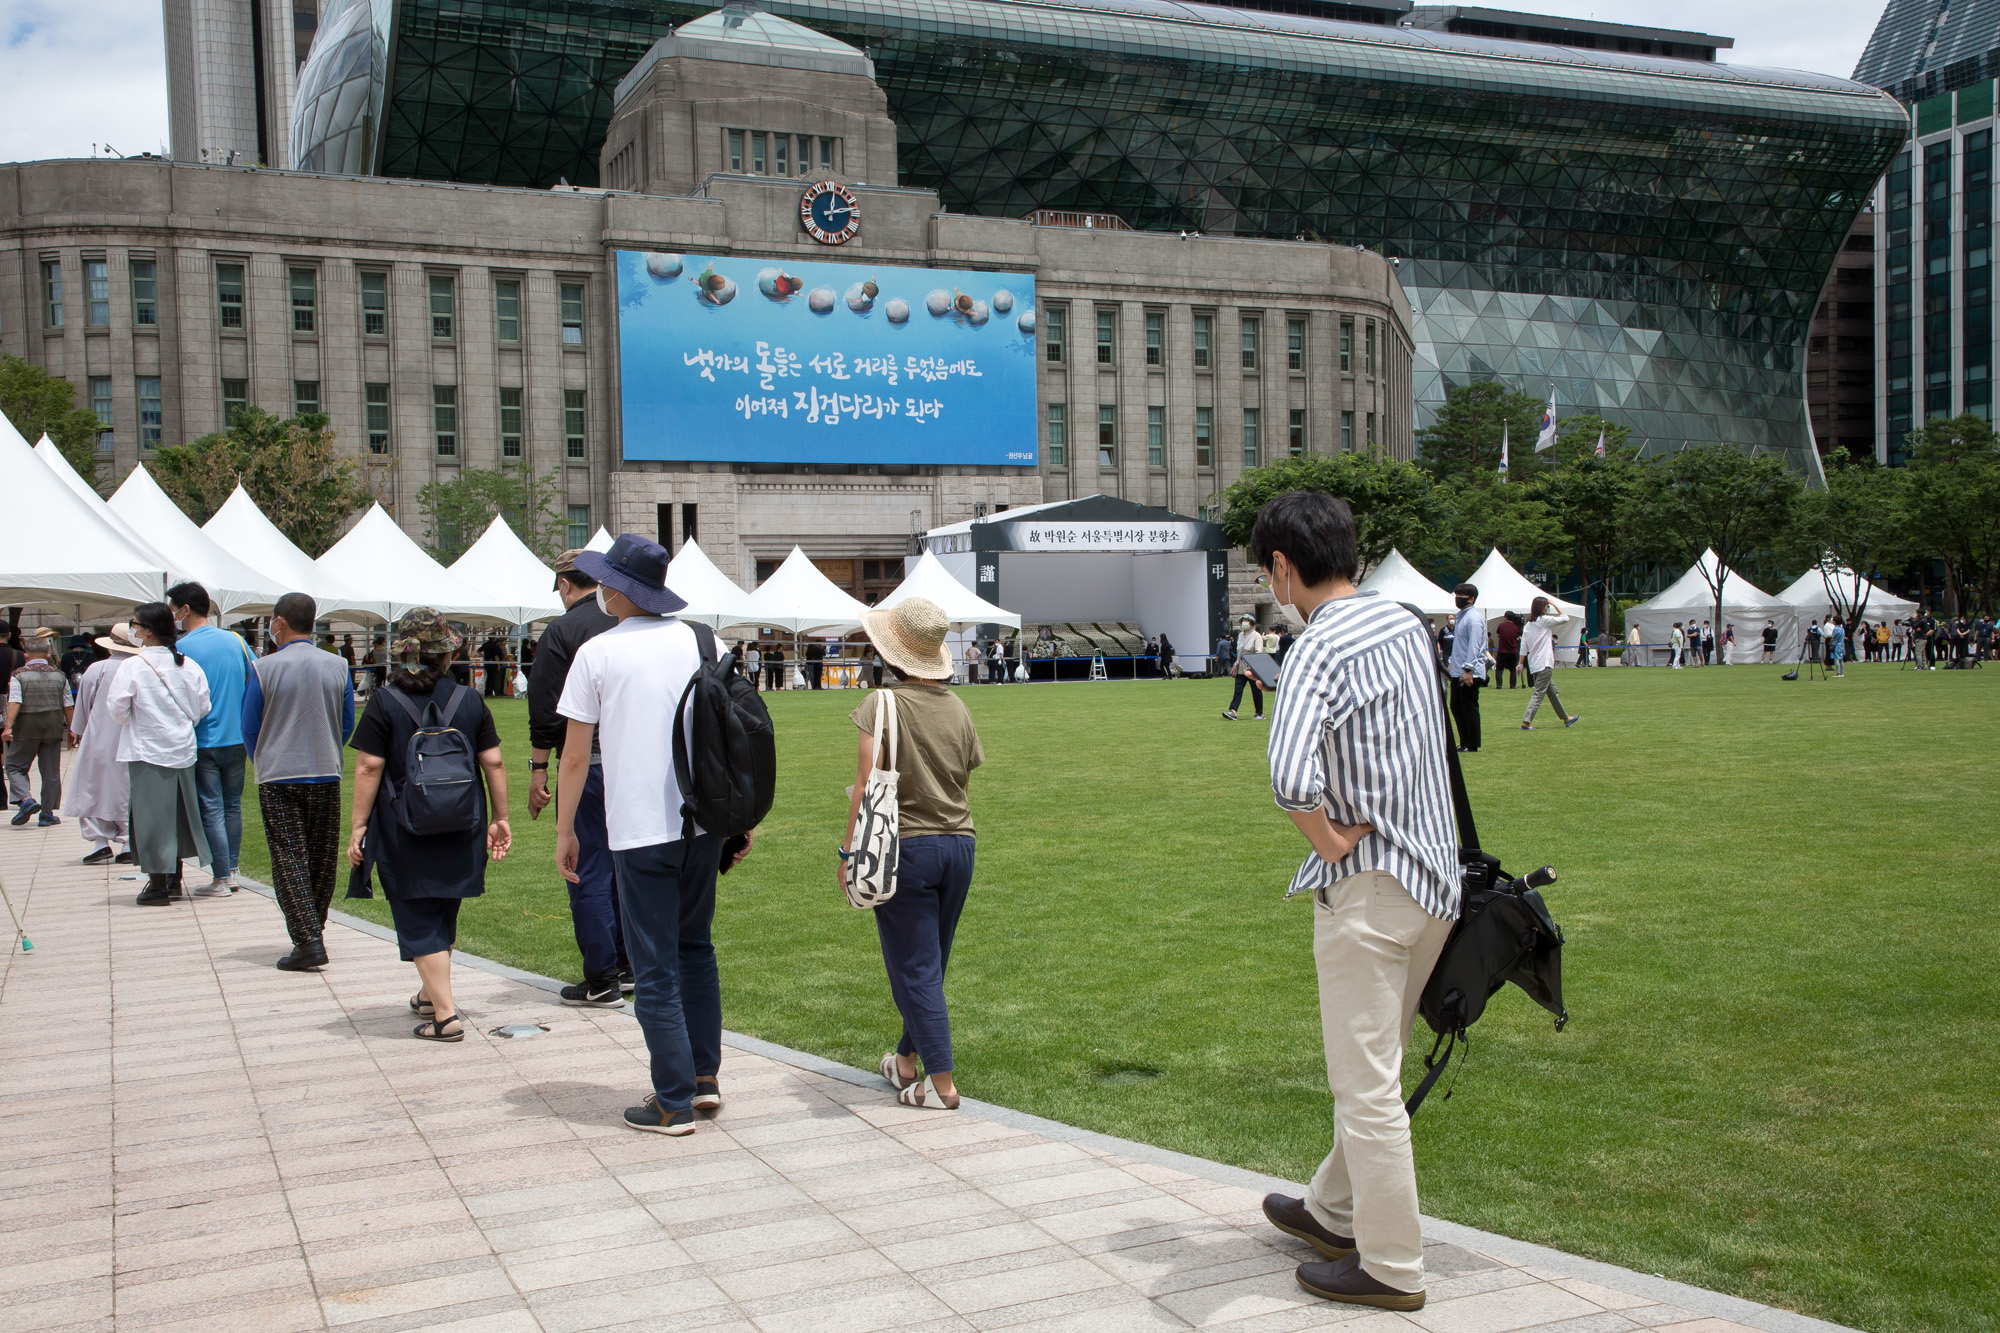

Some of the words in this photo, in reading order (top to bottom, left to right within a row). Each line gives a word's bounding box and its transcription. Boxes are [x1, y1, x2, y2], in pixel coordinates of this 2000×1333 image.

[684, 348, 749, 383] 냇가의
[756, 341, 802, 390] 돌들은
[809, 352, 851, 380] 서로
[854, 354, 898, 386] 거리를
[904, 356, 983, 382] 두었음에도
[735, 394, 788, 420] 이어져
[793, 386, 900, 425] 징검다리가
[906, 398, 944, 424] 된다
[1029, 530, 1041, 543] 故
[1044, 530, 1077, 543] 박원순
[1081, 530, 1145, 543] 서울특별시장
[1148, 530, 1180, 543] 분향소
[980, 565, 995, 582] 謹
[1212, 564, 1224, 580] 弔
